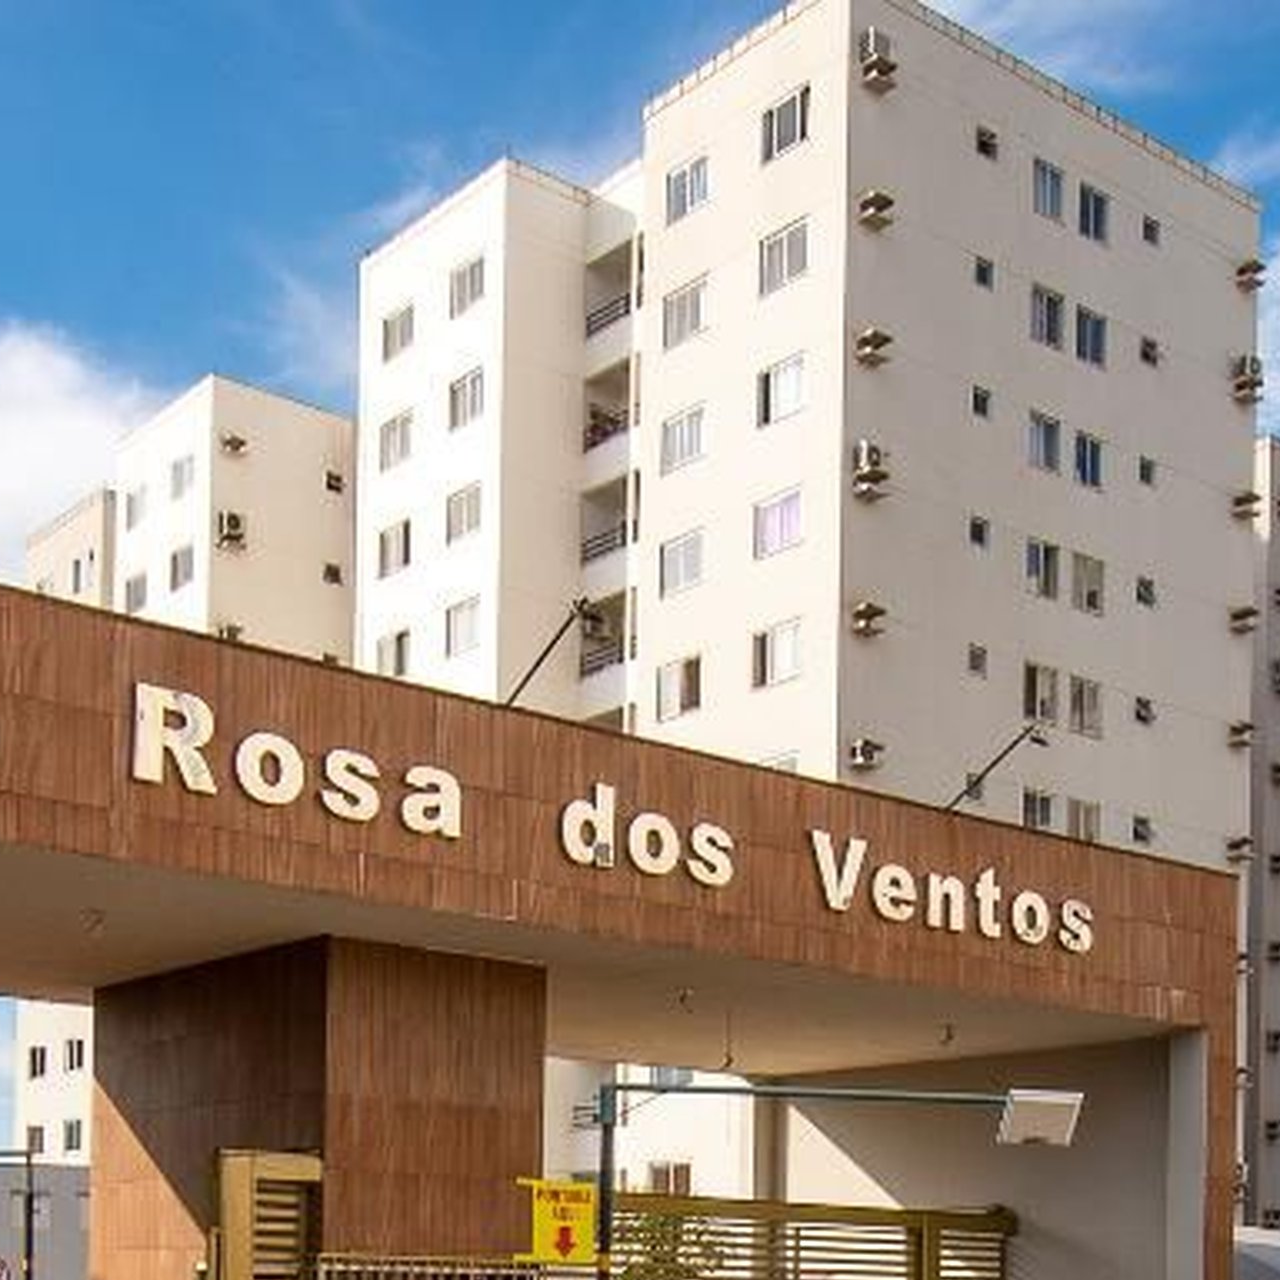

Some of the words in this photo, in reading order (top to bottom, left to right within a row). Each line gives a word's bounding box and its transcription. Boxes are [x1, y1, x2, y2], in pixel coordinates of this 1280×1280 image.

[131, 682, 462, 839] Rosa
[561, 783, 735, 887] dos
[812, 828, 1094, 952] Ventos
